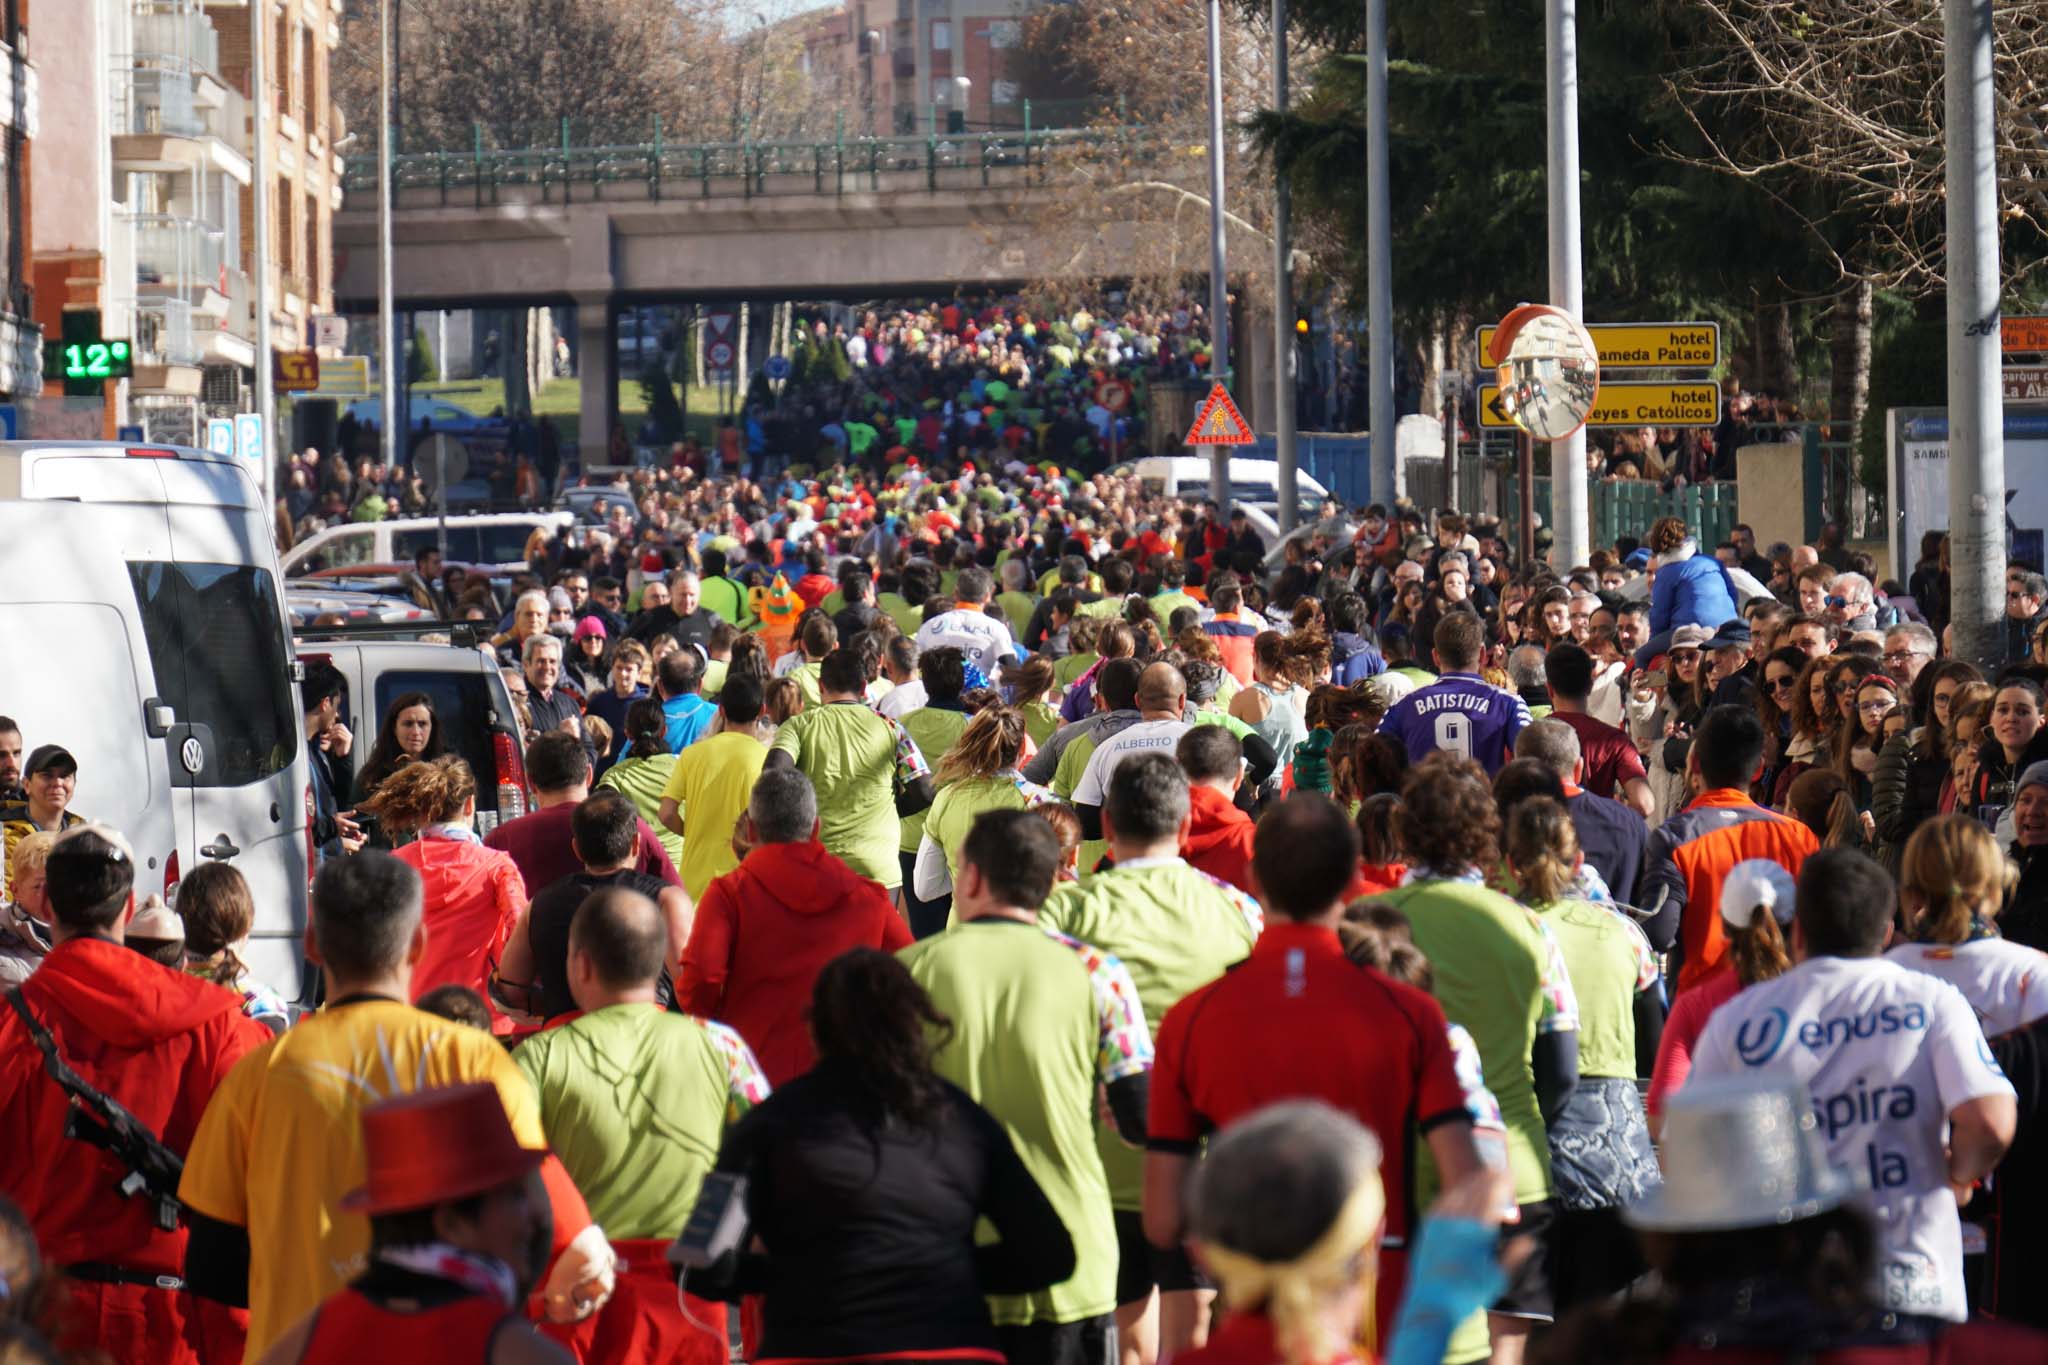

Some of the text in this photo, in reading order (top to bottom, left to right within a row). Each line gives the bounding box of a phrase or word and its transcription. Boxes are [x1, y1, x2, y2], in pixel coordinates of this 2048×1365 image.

[1670, 331, 1711, 345] hotel
[1599, 348, 1711, 362] ameda Palace
[1671, 390, 1712, 403] hotel
[1588, 405, 1712, 421] eyes Católicos
[1913, 449, 1950, 460] SAMS
[1415, 693, 1490, 716] BATISTUTA
[1434, 711, 1474, 761] 9
[1114, 736, 1172, 753] ALBERTO
[1797, 1002, 1927, 1049] enusa
[1867, 1141, 1908, 1191] la
